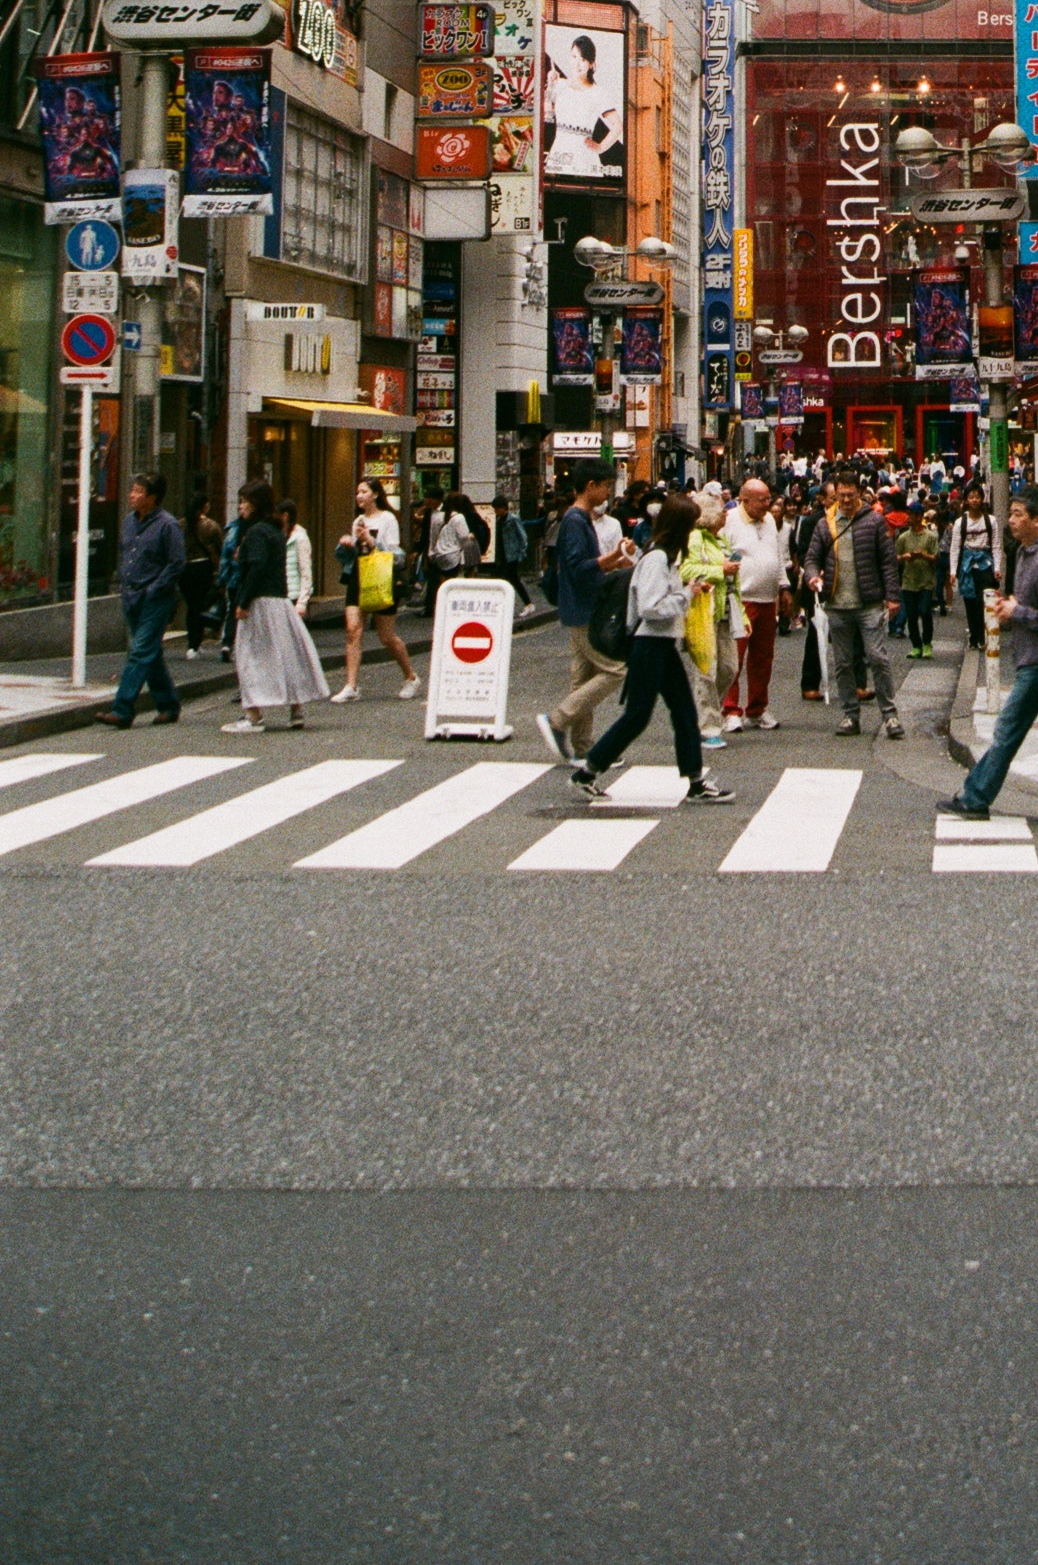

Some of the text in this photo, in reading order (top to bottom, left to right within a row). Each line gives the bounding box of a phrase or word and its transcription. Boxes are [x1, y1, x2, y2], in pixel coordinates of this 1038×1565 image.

[112, 2, 263, 24] 渋谷センター街
[705, 0, 732, 250] カラオケの鉄人
[826, 123, 881, 368] Bershka
[918, 196, 1018, 213] 渋谷センター街
